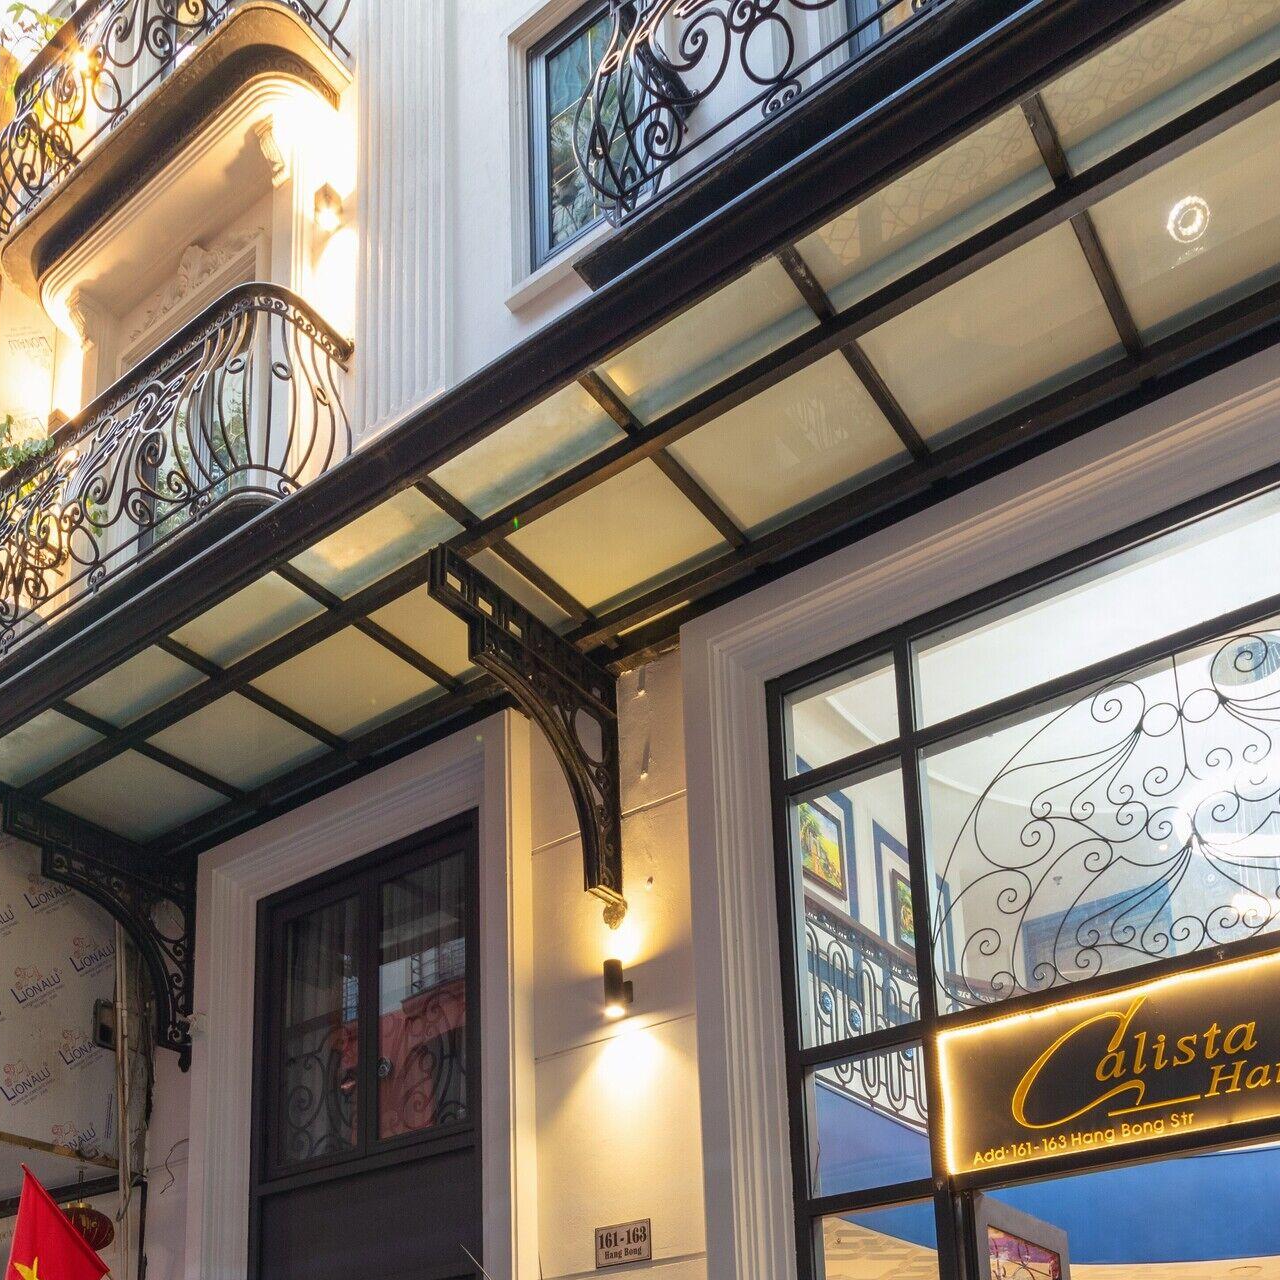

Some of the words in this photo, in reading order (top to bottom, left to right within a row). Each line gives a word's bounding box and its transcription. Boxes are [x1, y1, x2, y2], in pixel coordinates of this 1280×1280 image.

[1011, 993, 1258, 1129] Calista
[1071, 1126, 1116, 1147] Hang
[1121, 1116, 1165, 1138] Bong
[1170, 1111, 1196, 1128] Str
[598, 1225, 647, 1250] 161-163
[604, 1249, 622, 1260] Hang
[624, 1246, 642, 1258] Bong
